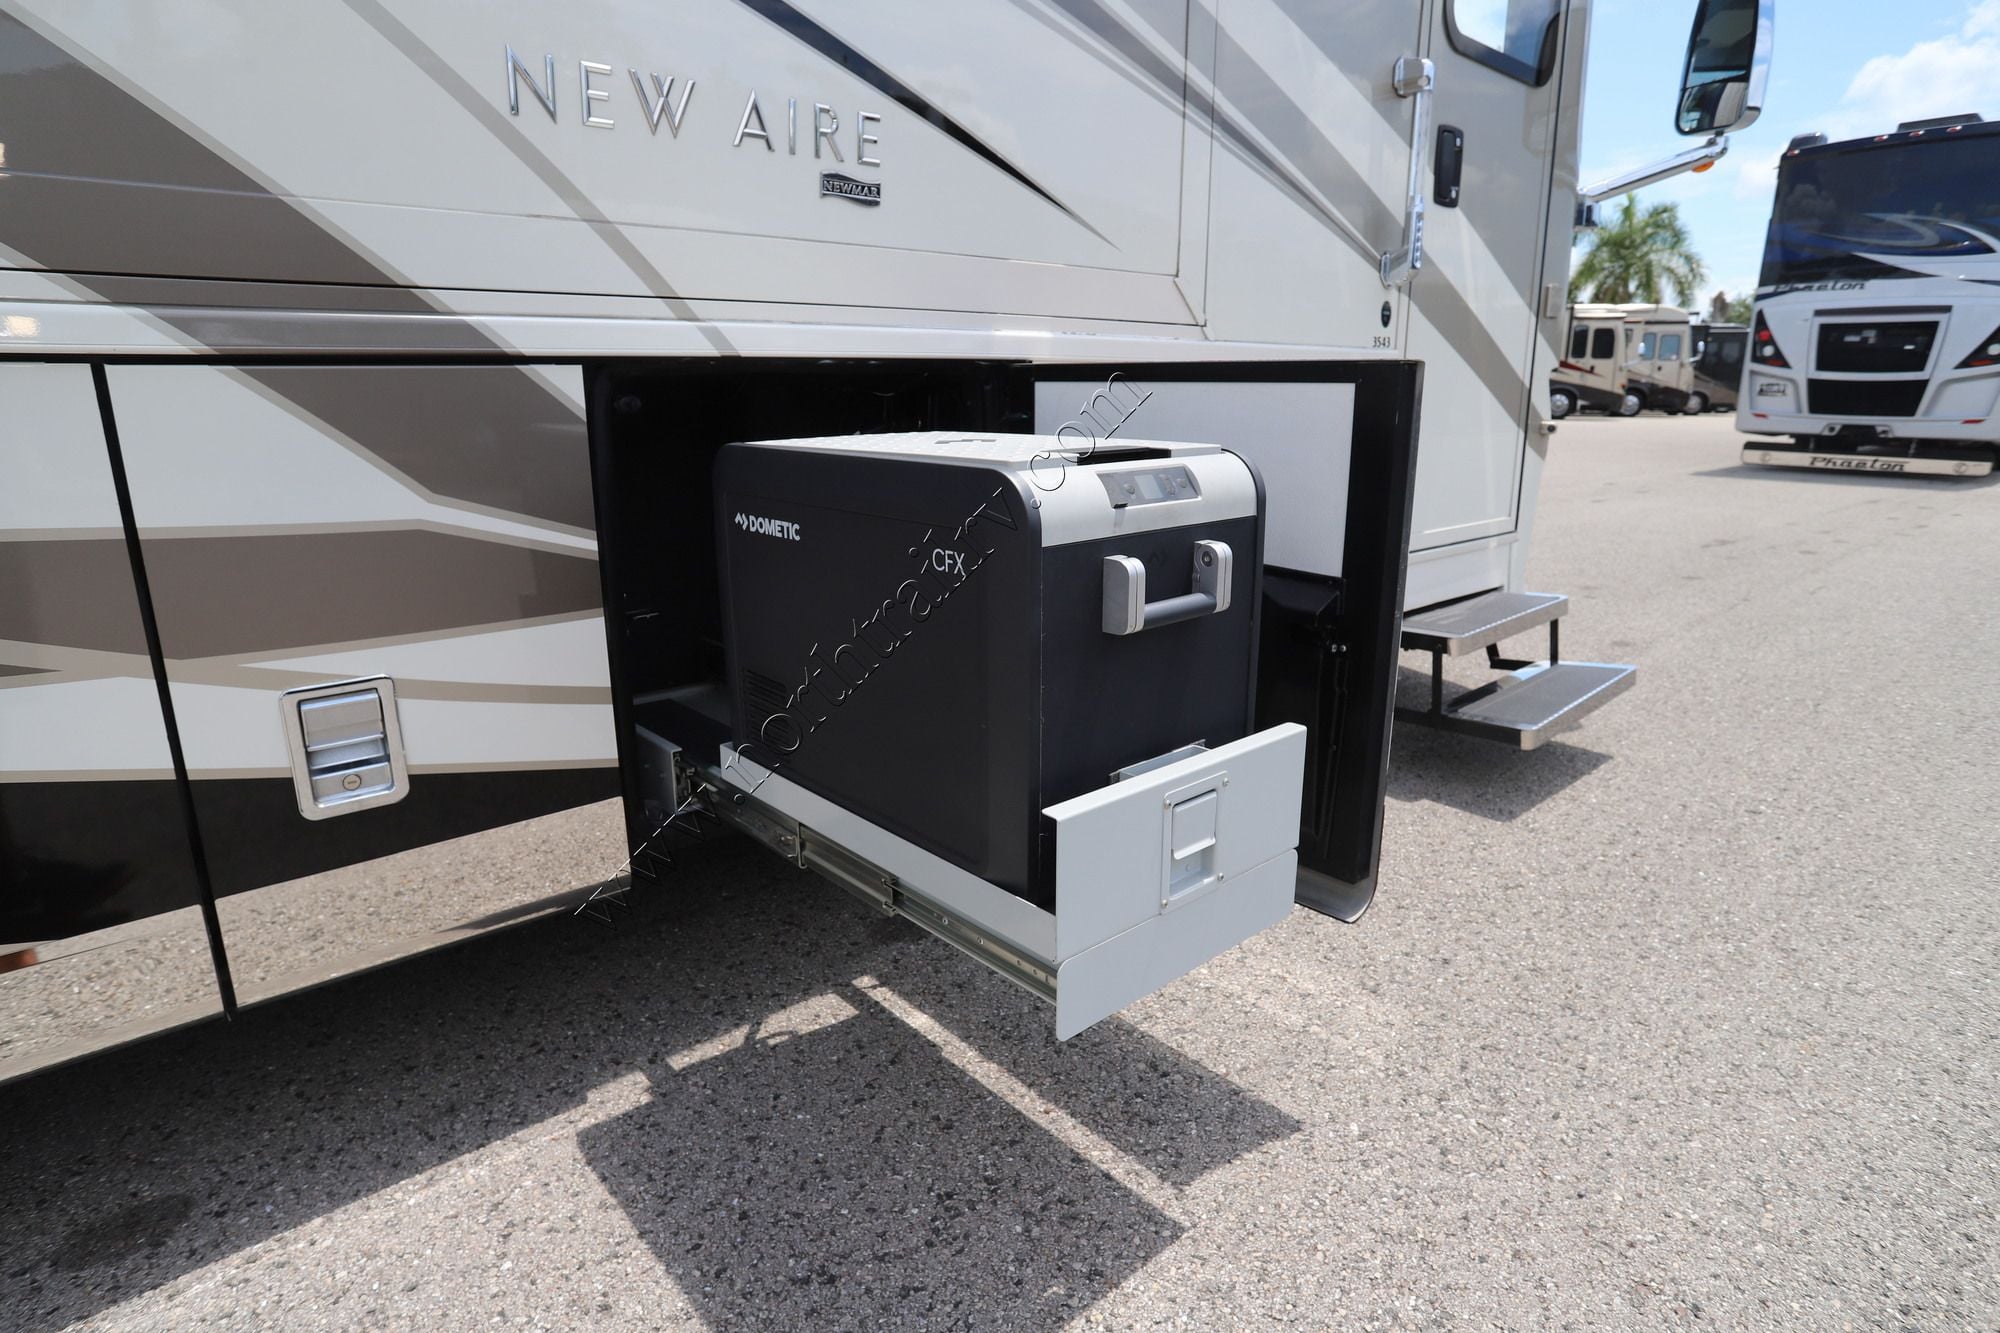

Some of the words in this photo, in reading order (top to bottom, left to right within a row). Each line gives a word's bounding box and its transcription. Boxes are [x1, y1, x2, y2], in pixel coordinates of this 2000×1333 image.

[505, 42, 695, 139] NEW
[732, 87, 881, 167] AIRE
[823, 180, 880, 198] NEWMAR
[1372, 336, 1391, 348] 3543
[1809, 456, 1908, 472] Phaeton
[749, 515, 800, 541] DOMETIC
[932, 548, 965, 576] CFX
